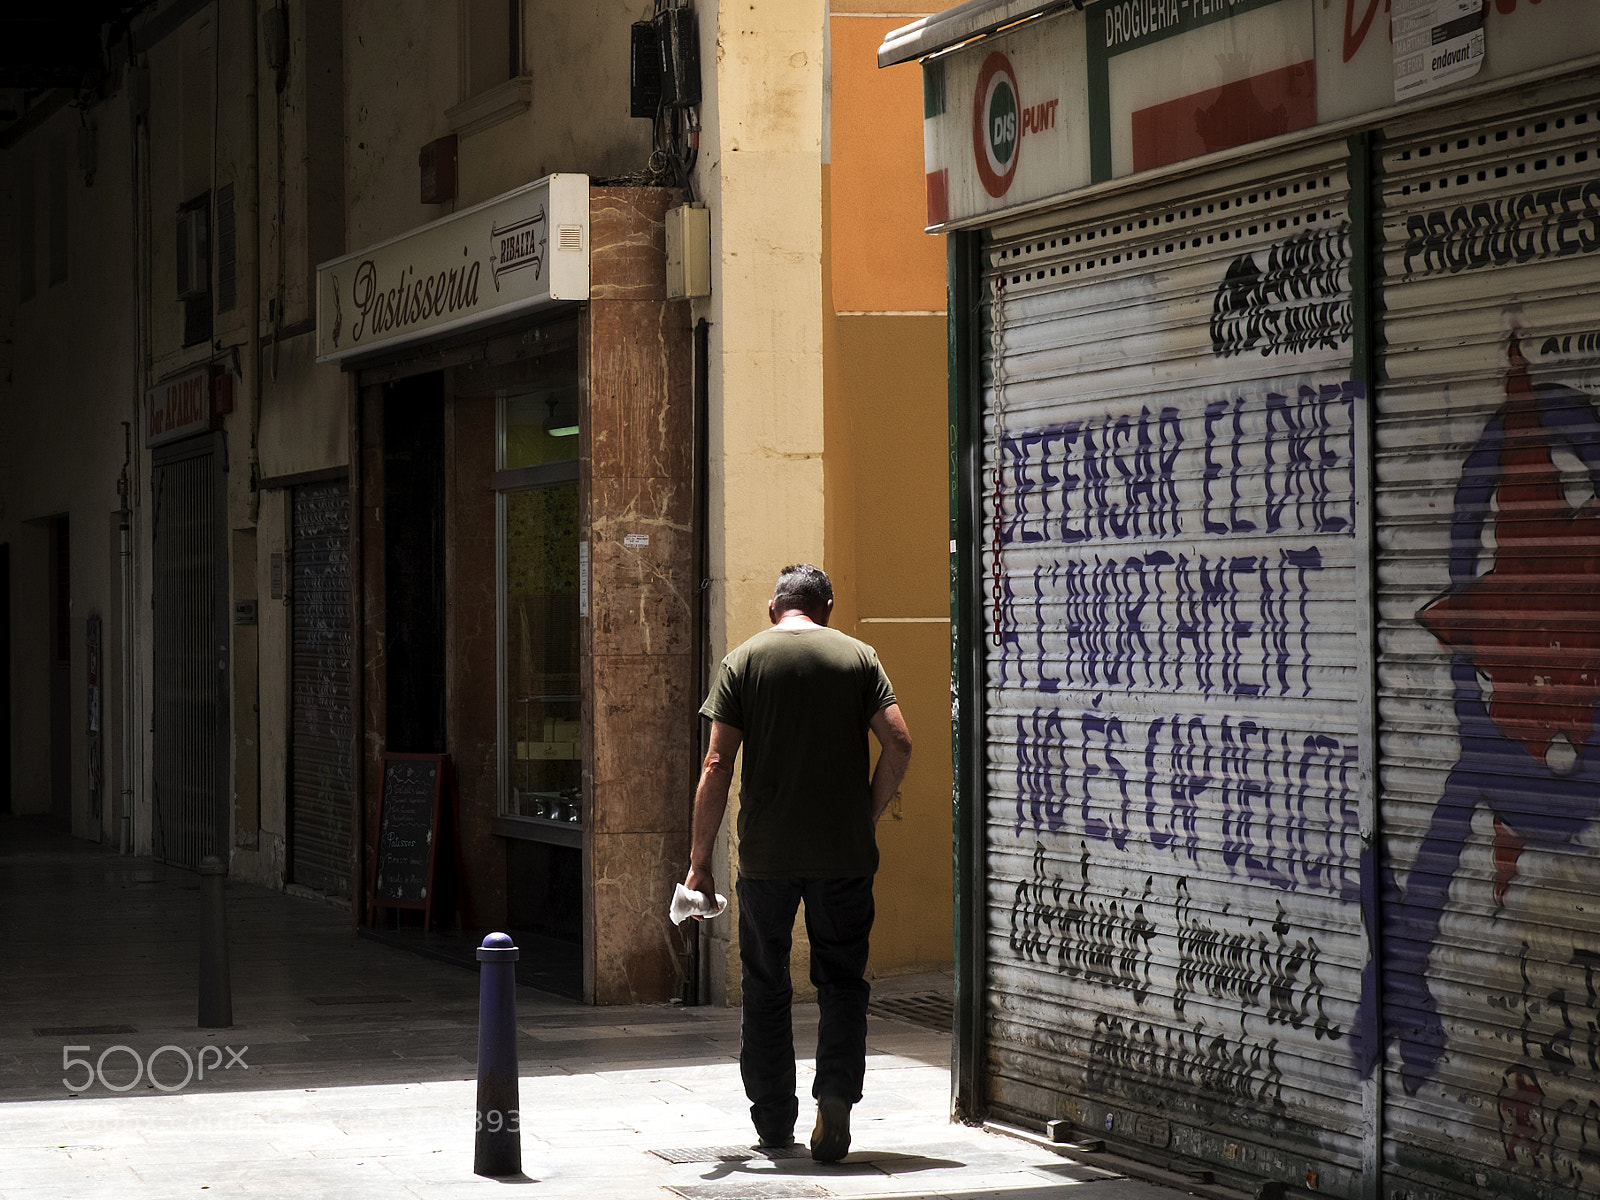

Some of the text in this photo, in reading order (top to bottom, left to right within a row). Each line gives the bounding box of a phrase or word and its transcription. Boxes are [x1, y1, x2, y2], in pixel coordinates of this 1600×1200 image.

[1432, 43, 1470, 71] endavant
[993, 111, 1016, 146] DIS
[1022, 98, 1059, 137] PUNT
[500, 228, 537, 265] RIBALTA
[1402, 179, 1600, 281] PRODUCTES
[352, 245, 481, 342] Pastisseria
[1000, 405, 1185, 543] DEFENSAR
[1203, 397, 1257, 535] EL
[1015, 705, 1070, 838] NO
[1144, 713, 1214, 870] CAP
